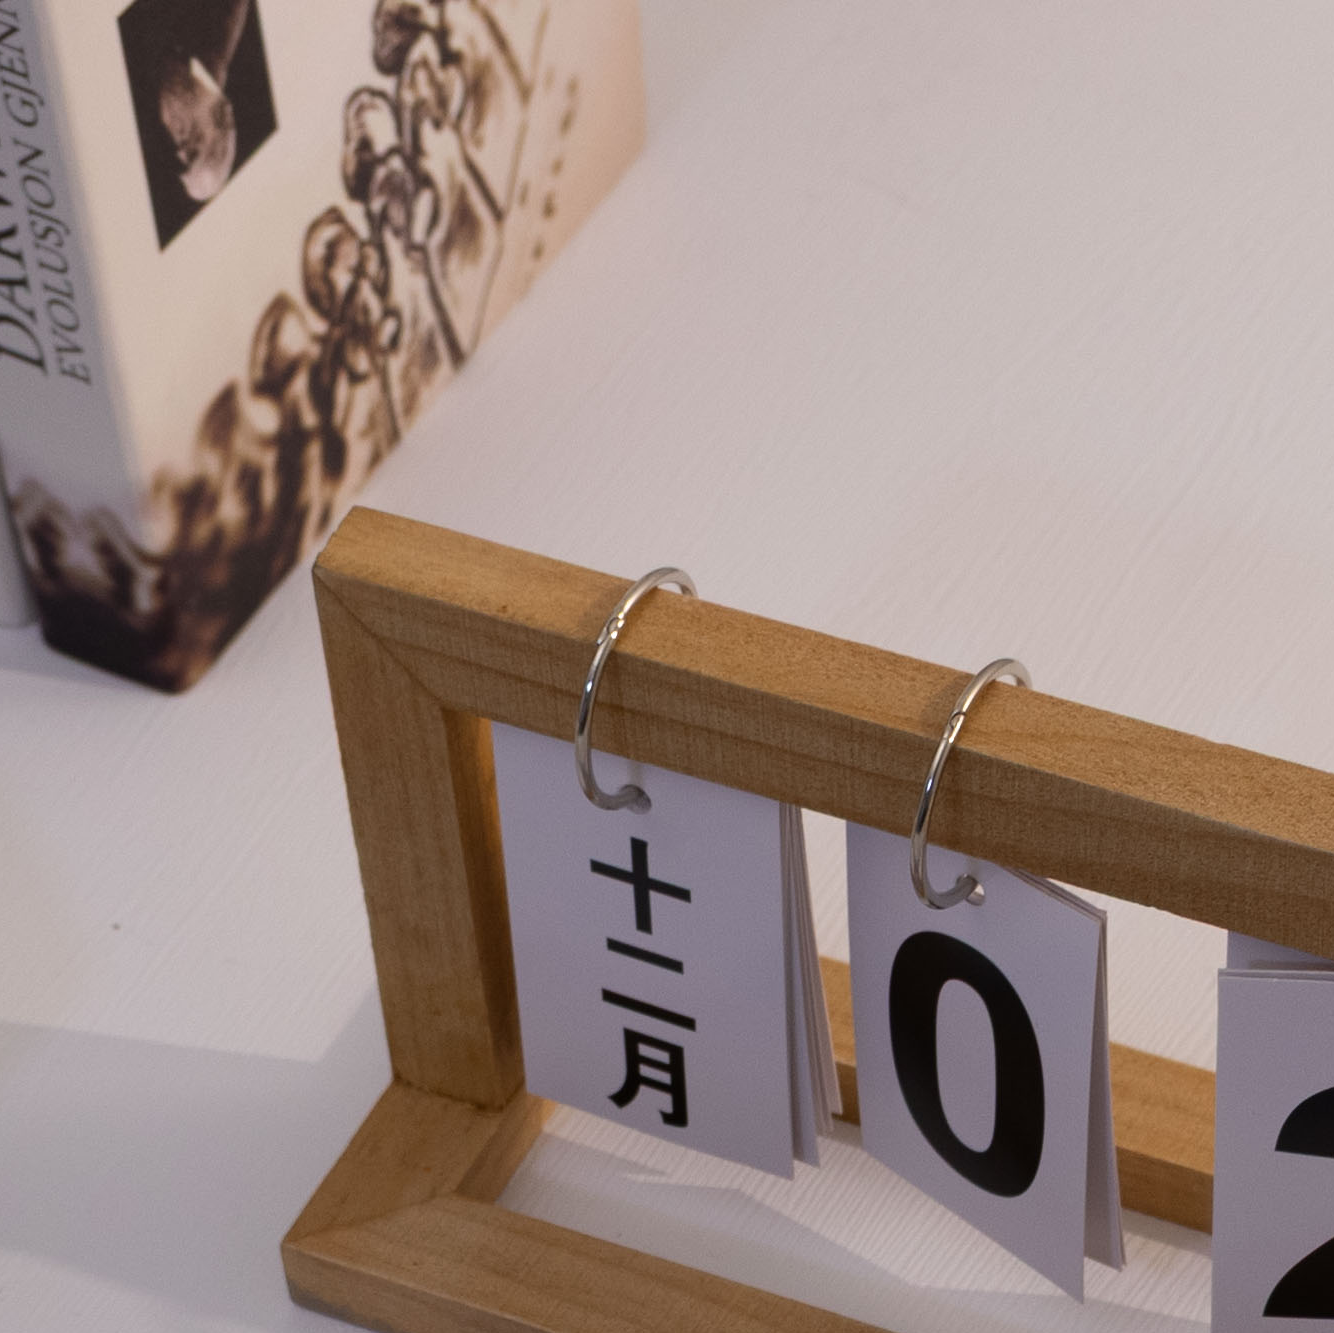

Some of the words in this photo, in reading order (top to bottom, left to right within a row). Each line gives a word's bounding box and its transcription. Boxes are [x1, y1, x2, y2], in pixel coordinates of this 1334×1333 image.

[12, 137, 92, 385] EVOLUSJON
[590, 837, 696, 1128] 十二月
[889, 931, 1045, 1198] 0
